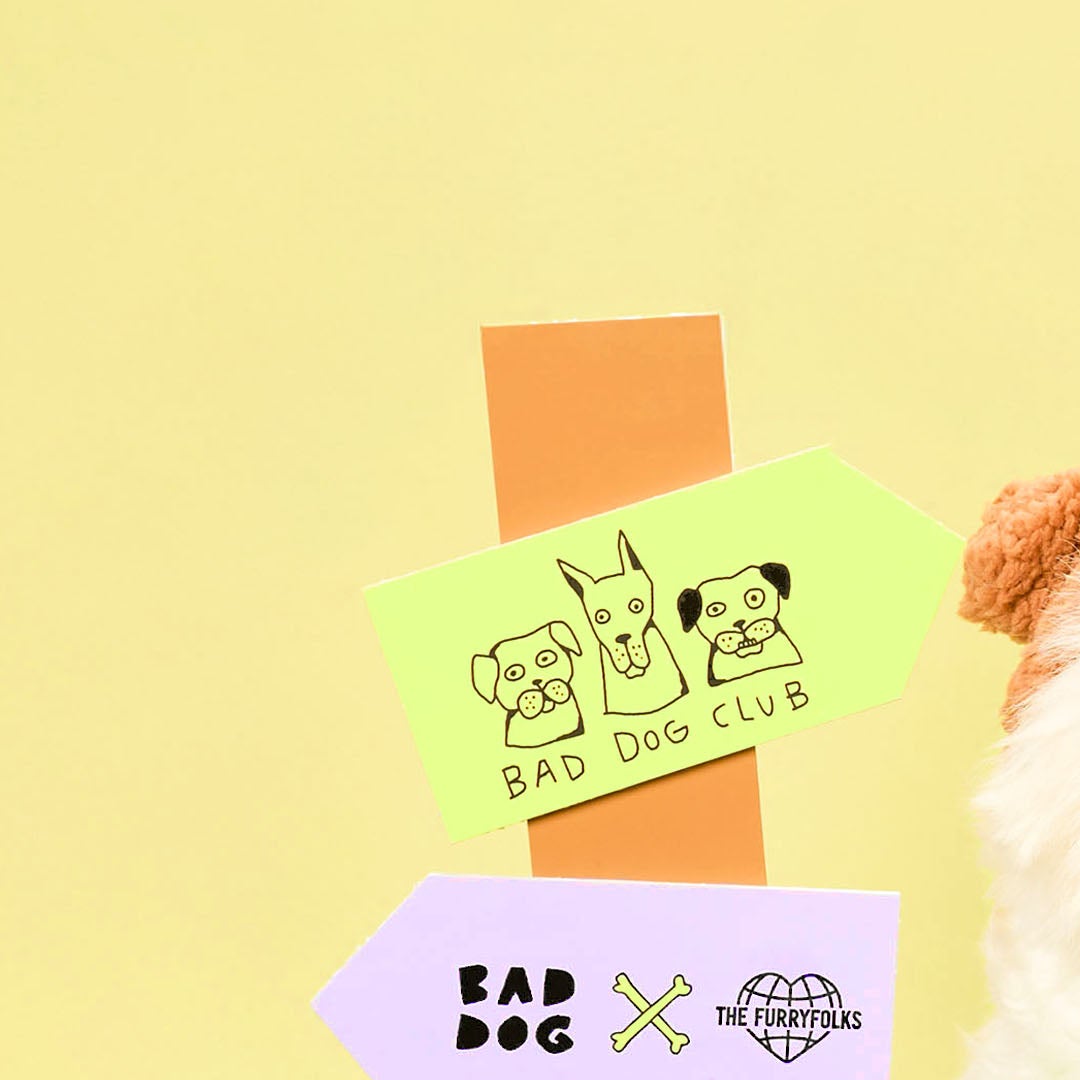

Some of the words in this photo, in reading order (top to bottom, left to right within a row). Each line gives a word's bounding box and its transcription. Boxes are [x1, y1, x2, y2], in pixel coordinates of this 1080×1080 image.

[502, 754, 585, 799] BAD
[614, 720, 689, 762] DOG
[713, 681, 809, 728] CLUB
[458, 964, 576, 1006] BAD
[456, 1013, 575, 1054] DOG
[715, 1006, 748, 1027] THE
[754, 1007, 862, 1030] FURRYFOLKS
